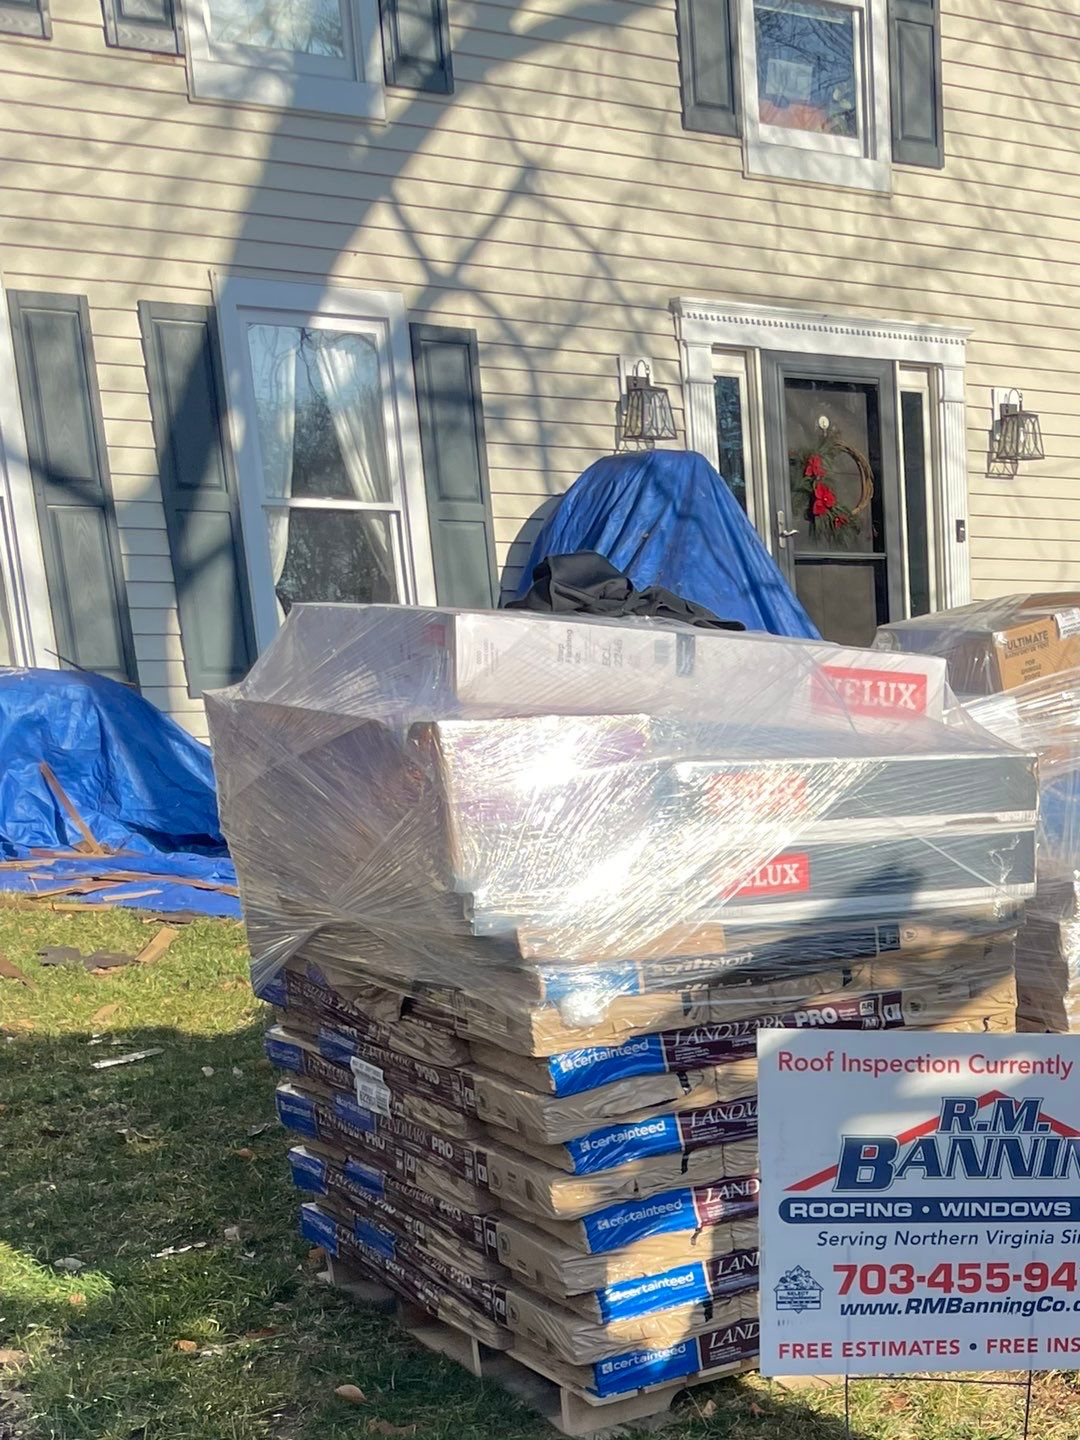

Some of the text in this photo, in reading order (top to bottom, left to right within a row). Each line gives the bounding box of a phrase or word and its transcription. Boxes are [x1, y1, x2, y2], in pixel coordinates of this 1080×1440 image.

[742, 863, 800, 887] LUX
[572, 1039, 649, 1069] certainteed
[674, 1015, 785, 1048] LANDMARK
[794, 1007, 838, 1027] PRO
[778, 1051, 834, 1073] Roof
[842, 1053, 960, 1079] Inspection
[968, 1054, 1074, 1081] Currently
[591, 1121, 665, 1150] certainteed
[691, 1102, 758, 1128] LANDM
[937, 1096, 1051, 1135] R.M.
[431, 1135, 453, 1159] PRO
[610, 1199, 683, 1228] certainteed
[703, 1179, 760, 1205] LAND
[789, 1202, 913, 1218] ROOFING
[940, 1201, 1071, 1217] WINDOWS
[817, 1230, 888, 1248] Serving
[894, 1230, 979, 1246] Northern
[986, 1229, 1055, 1247] Virginia
[613, 1344, 686, 1372] certainteed
[710, 1324, 760, 1349] LAND
[778, 1343, 833, 1360] FREE
[842, 1339, 960, 1358] ESTIMATES
[986, 1338, 1038, 1354] FREE
